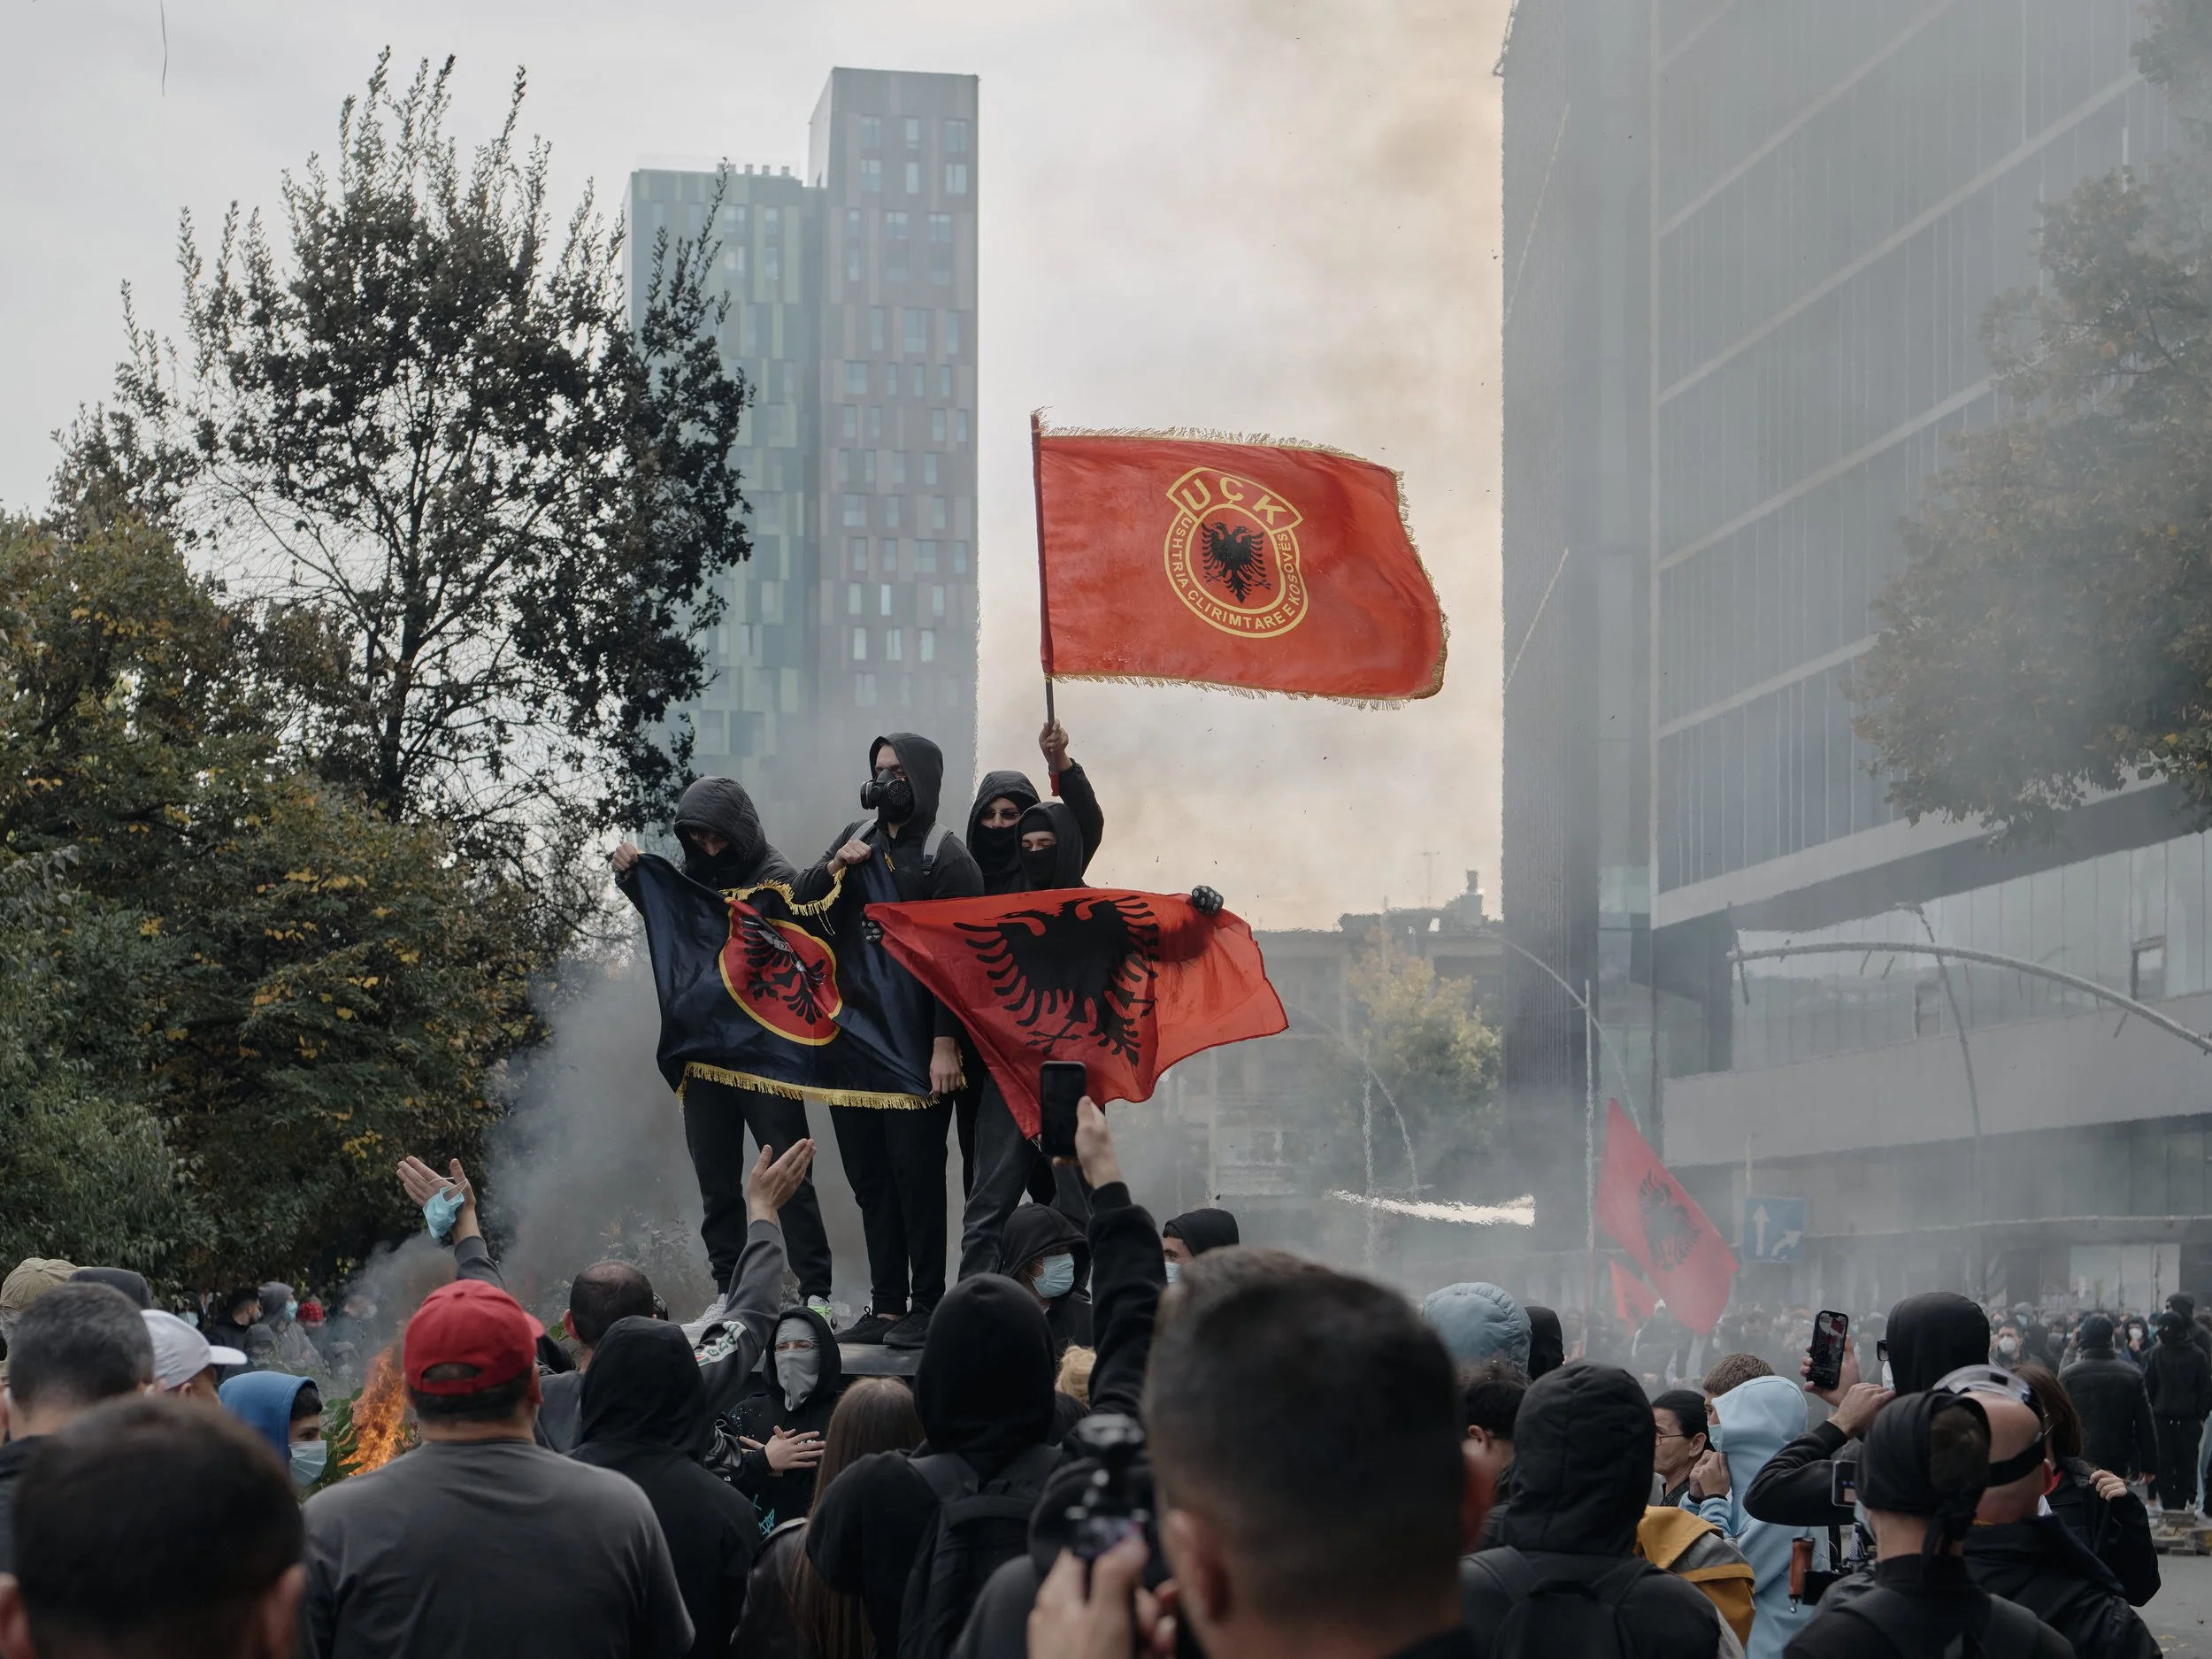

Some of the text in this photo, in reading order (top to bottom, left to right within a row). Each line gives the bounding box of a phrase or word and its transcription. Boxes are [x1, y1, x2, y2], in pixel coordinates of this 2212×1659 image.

[1180, 476, 1288, 526] UÇK
[1171, 517, 1301, 630] USHTRIA ÇLIRIMTARE E KOSOVËS
